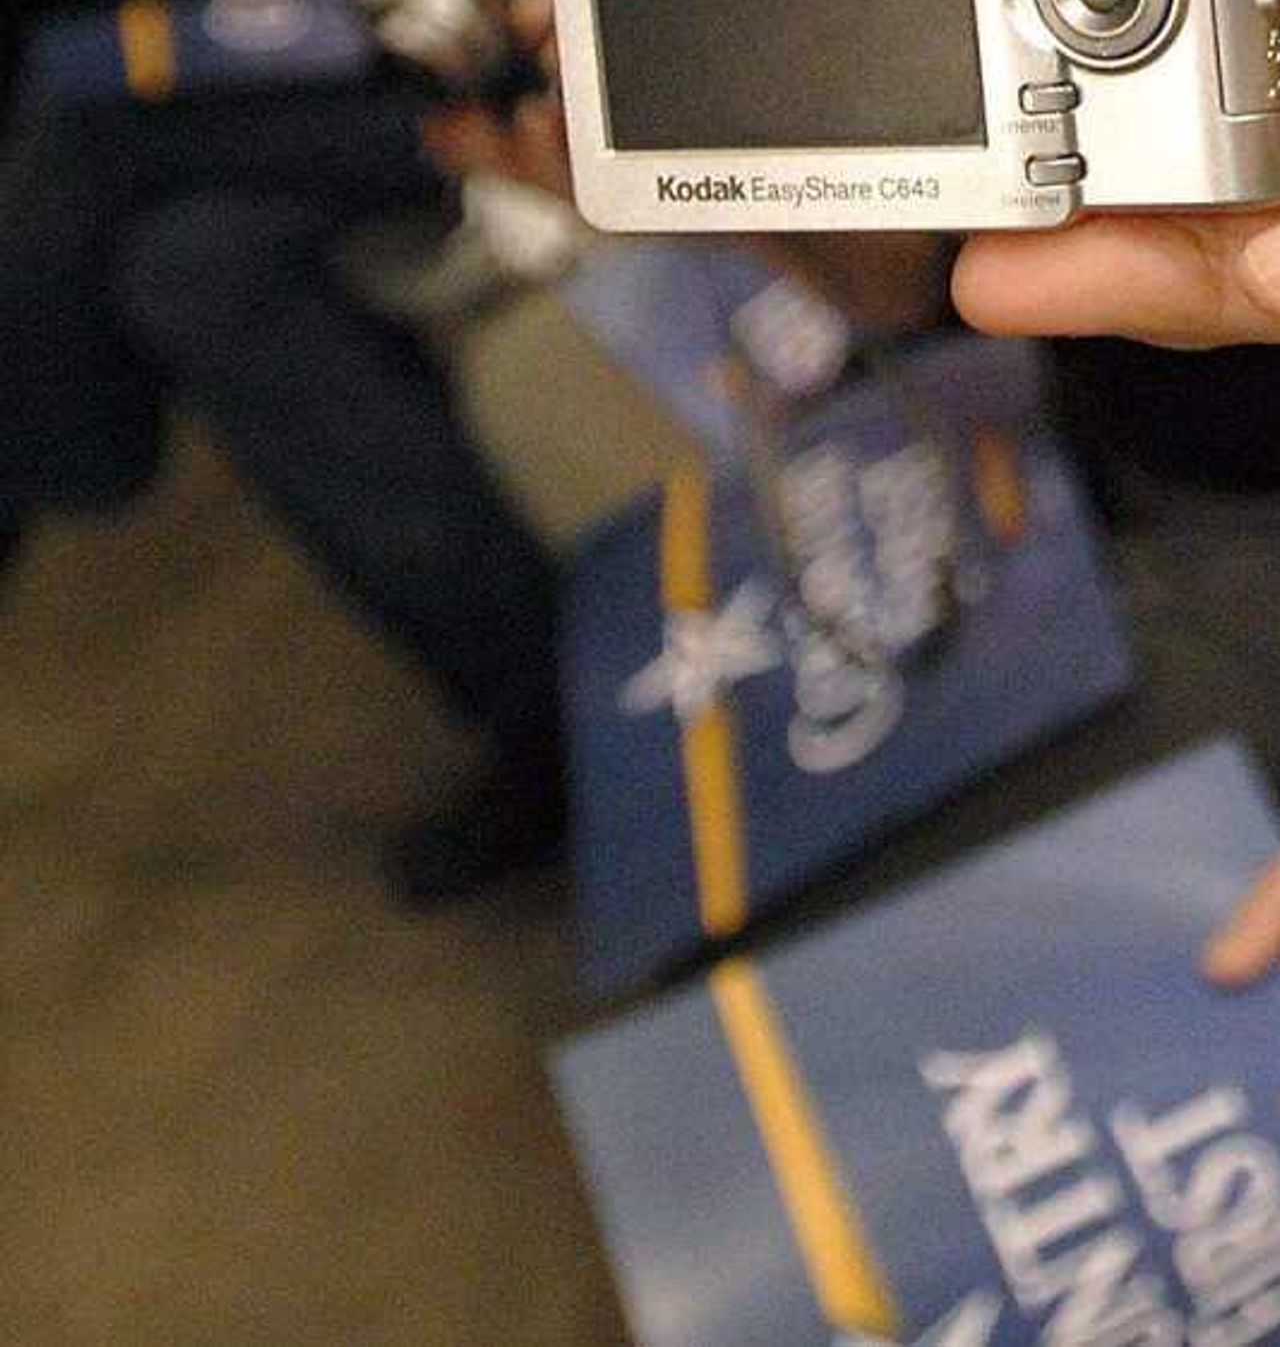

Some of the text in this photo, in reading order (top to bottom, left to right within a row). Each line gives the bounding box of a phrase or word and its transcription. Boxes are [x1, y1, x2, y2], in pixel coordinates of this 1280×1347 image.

[657, 175, 940, 206] Kodak EasyShare C643
